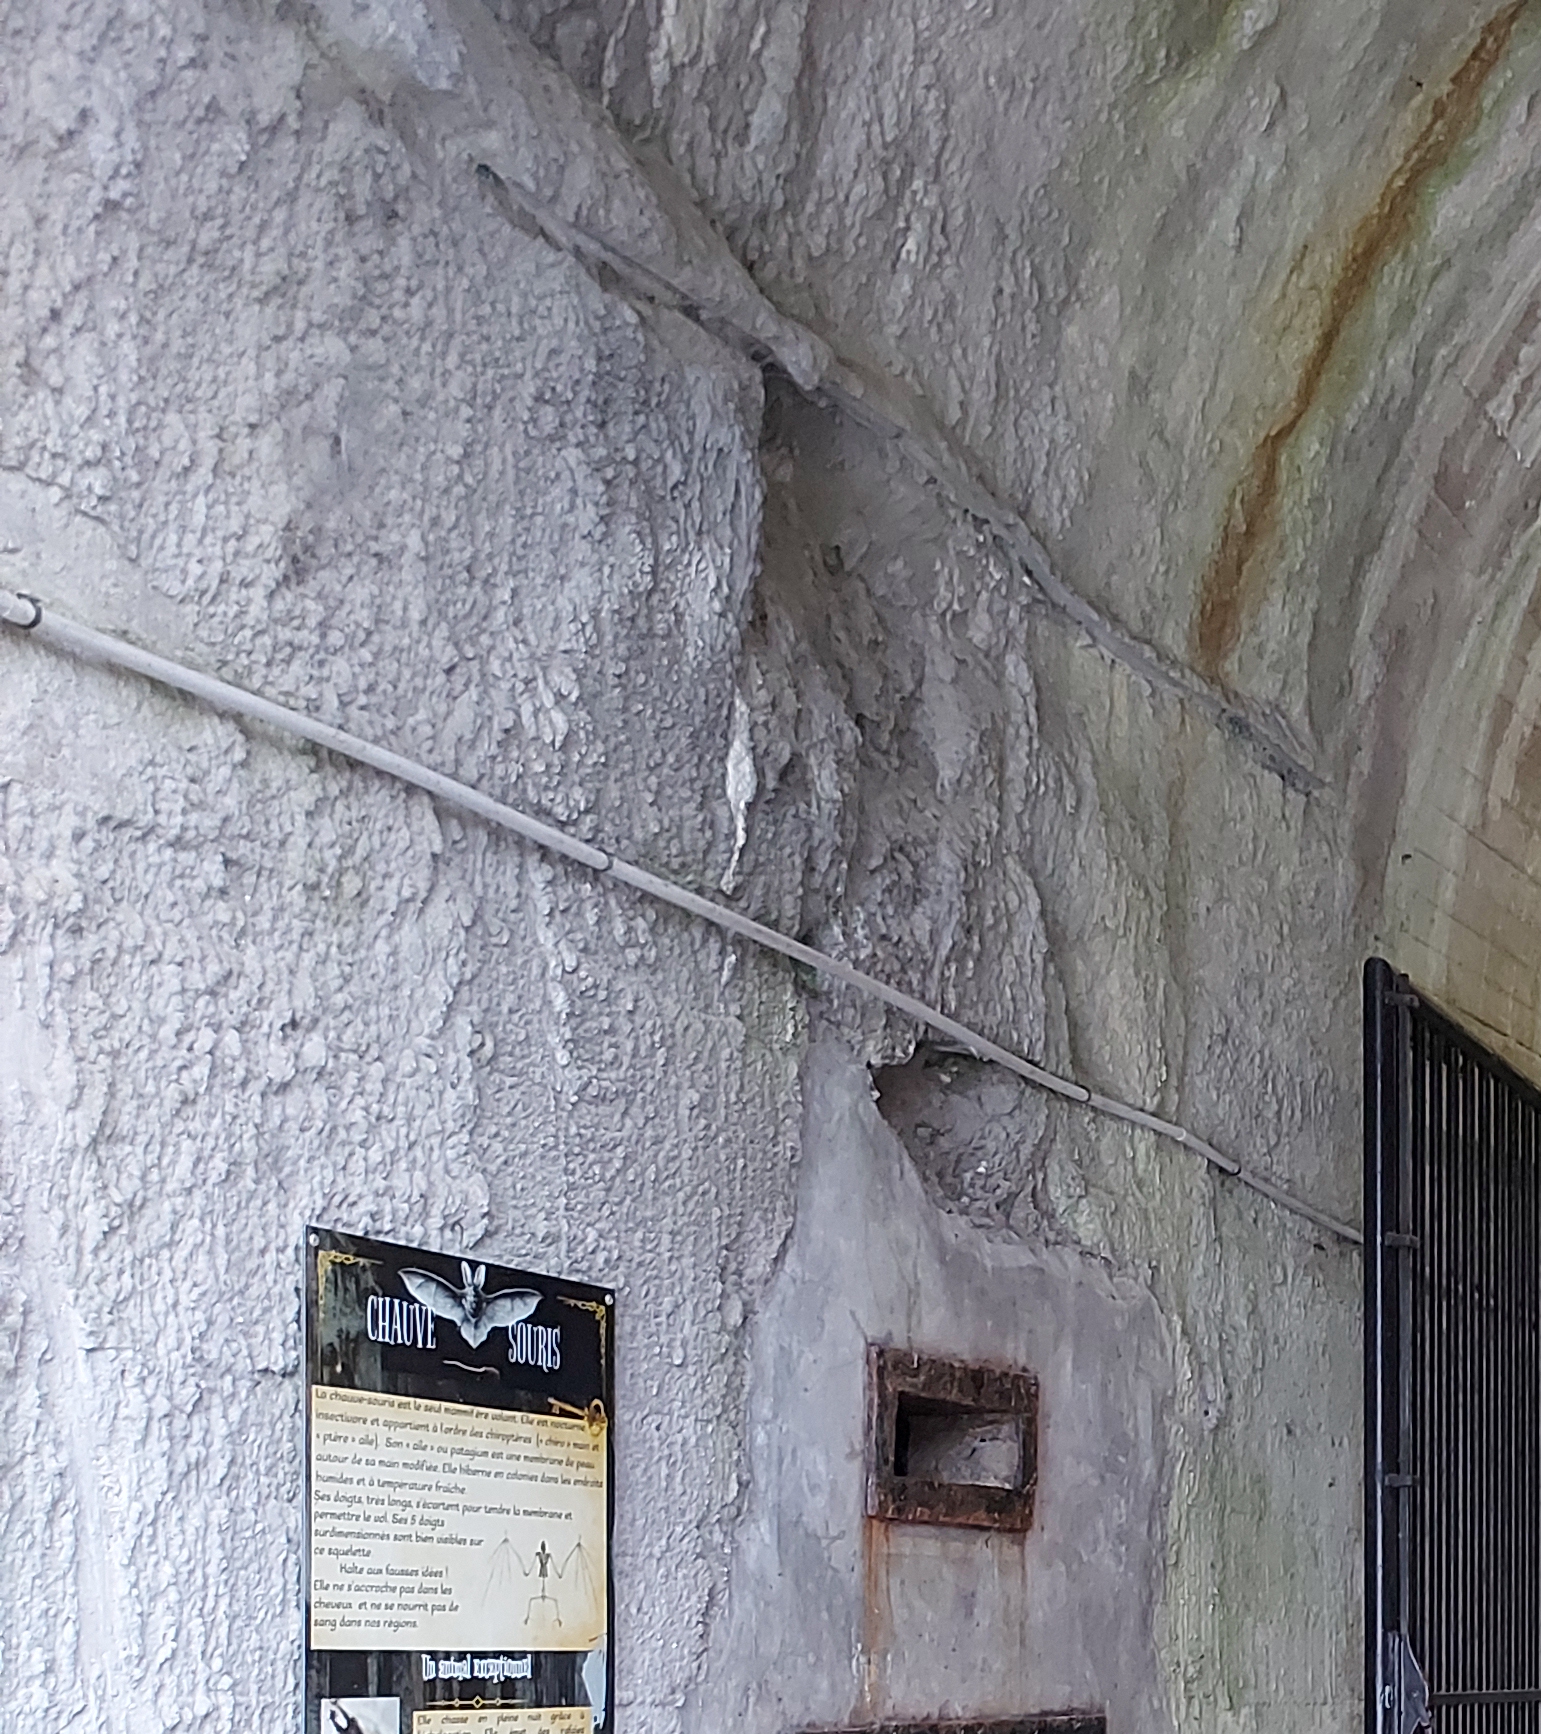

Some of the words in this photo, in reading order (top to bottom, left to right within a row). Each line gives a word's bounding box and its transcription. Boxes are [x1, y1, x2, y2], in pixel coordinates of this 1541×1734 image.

[366, 1295, 436, 1348] CHAUVE
[507, 1316, 560, 1371] SOURIS
[397, 1400, 411, 1410] est
[370, 1417, 379, 1426] et
[385, 1436, 403, 1448] Son
[315, 1453, 348, 1463] autour
[351, 1453, 361, 1465] de
[365, 1458, 375, 1466] sa
[356, 1477, 365, 1486] et
[314, 1489, 330, 1501] Ses
[462, 1504, 481, 1516] pour
[363, 1510, 371, 1522] le
[391, 1512, 407, 1524] Ses
[410, 1514, 415, 1525] 5
[418, 1514, 444, 1531] doigts
[393, 1533, 413, 1542] sont
[415, 1531, 434, 1543] bien
[470, 1538, 484, 1546] sur
[314, 1546, 324, 1555] ce
[339, 1562, 363, 1574] Halte
[313, 1578, 329, 1591] Elle
[333, 1583, 344, 1591] ne
[347, 1580, 396, 1593] s'accroche
[399, 1585, 414, 1598] pas
[417, 1582, 437, 1594] dans
[440, 1583, 452, 1595] les
[358, 1600, 367, 1610] et
[370, 1602, 381, 1610] ne
[384, 1602, 394, 1610] se
[431, 1603, 446, 1616] pas
[313, 1618, 336, 1631] sang
[340, 1614, 361, 1627] dans
[364, 1619, 380, 1627] nos
